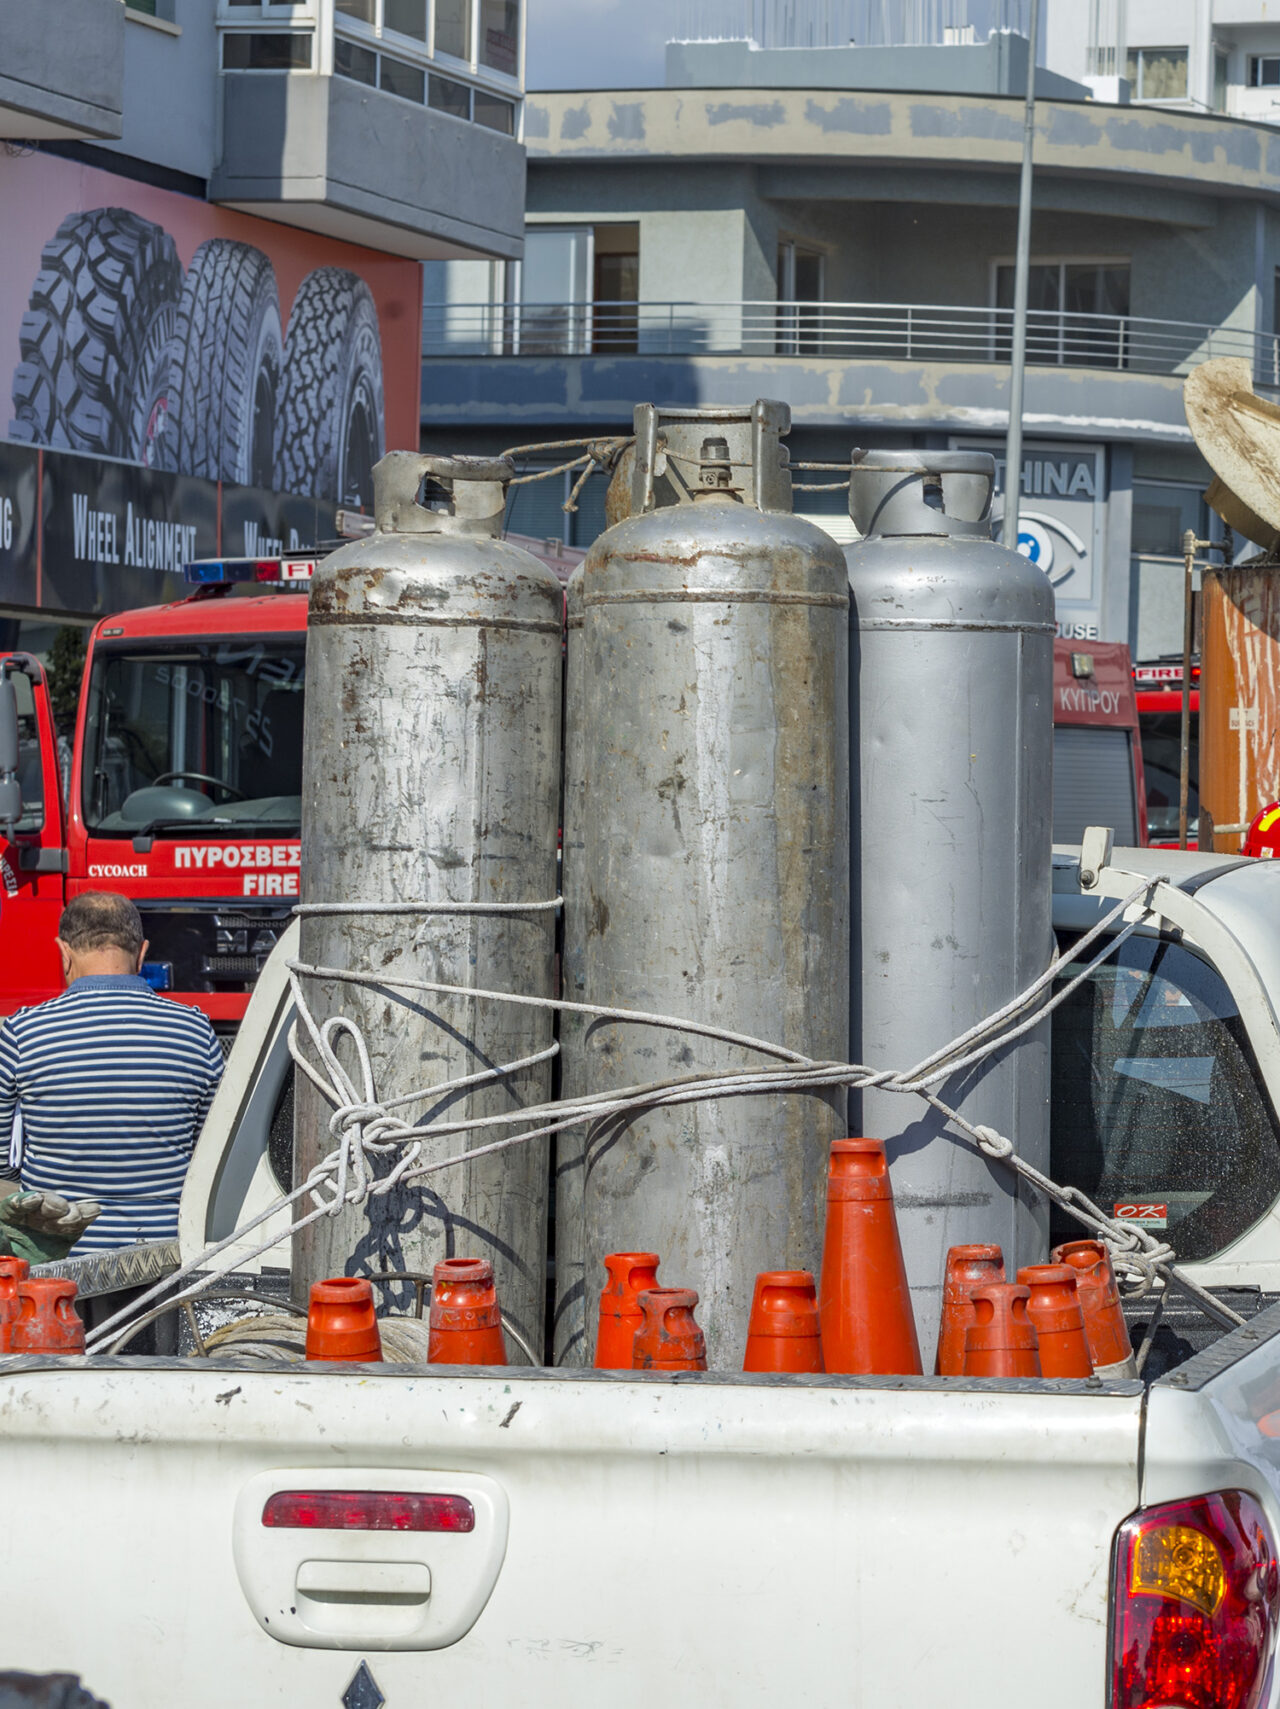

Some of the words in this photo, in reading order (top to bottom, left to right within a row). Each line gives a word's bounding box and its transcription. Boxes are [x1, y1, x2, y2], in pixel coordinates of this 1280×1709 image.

[0, 497, 12, 550] G
[72, 493, 120, 565] WHEEL
[124, 501, 197, 573] ALIGNMENT
[1138, 668, 1184, 679] FIRE
[1060, 687, 1120, 714] ΚΥΠΡΟΥ
[174, 846, 300, 868] ΠΥΡΟΣΒΕΣ
[88, 864, 148, 877] CYCOACH
[243, 873, 298, 896] FIRE
[1117, 1205, 1164, 1218] OK
